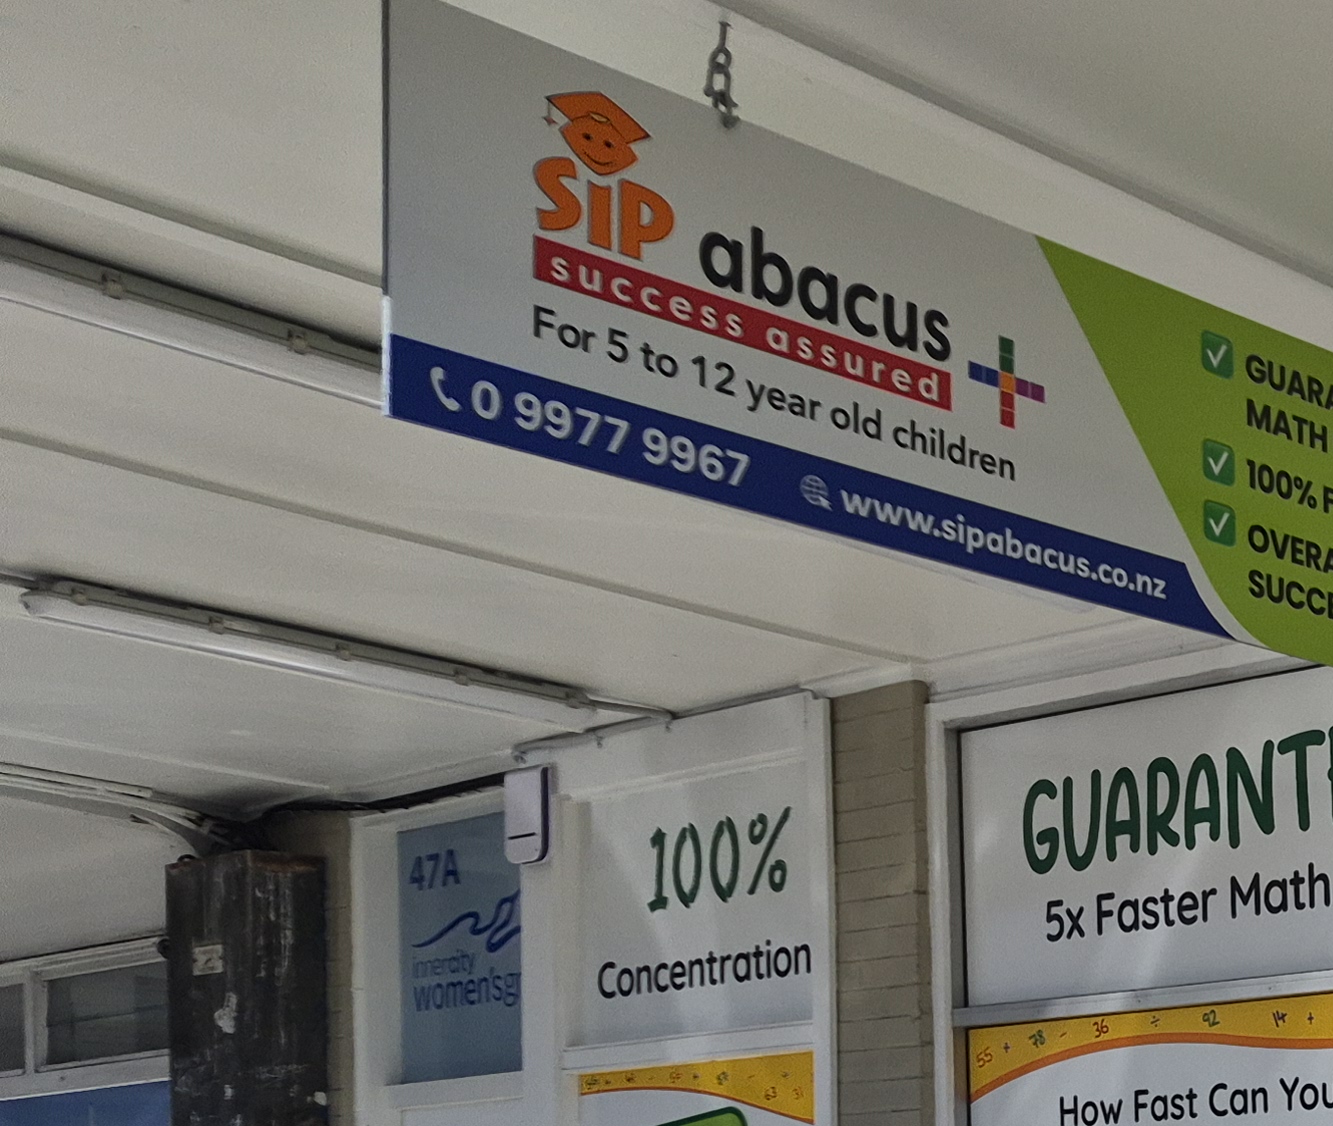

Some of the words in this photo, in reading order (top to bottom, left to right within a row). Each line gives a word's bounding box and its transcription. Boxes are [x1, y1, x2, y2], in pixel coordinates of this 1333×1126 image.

[533, 157, 674, 261] SIP
[700, 227, 951, 361] abacus
[550, 256, 743, 338] success
[766, 325, 941, 403] assured
[471, 380, 500, 420] 0
[514, 391, 630, 453] 9977
[641, 426, 750, 486] 9967
[533, 305, 595, 355] For
[607, 329, 628, 363] 5
[640, 341, 678, 379] to
[692, 355, 735, 395] 12
[747, 377, 821, 420] year
[830, 399, 881, 441] old
[893, 419, 1016, 481] children
[1246, 399, 1327, 453] MATH
[1246, 459, 1316, 510] 100%
[839, 486, 1167, 600] www.sipabacus.co.nz
[409, 849, 460, 890] 47A
[647, 806, 791, 912] 100%
[1045, 899, 1085, 942] 5x
[1097, 885, 1217, 936] Faster
[1230, 862, 1331, 919] Math
[598, 940, 811, 999] Concentration
[976, 1047, 993, 1068] 55
[1029, 1029, 1047, 1048] 78
[1093, 1018, 1110, 1038] 36
[1202, 1009, 1221, 1027] 92
[1272, 1011, 1288, 1028] 14
[1133, 1087, 1198, 1125] Fast
[1208, 1082, 1269, 1118] Can
